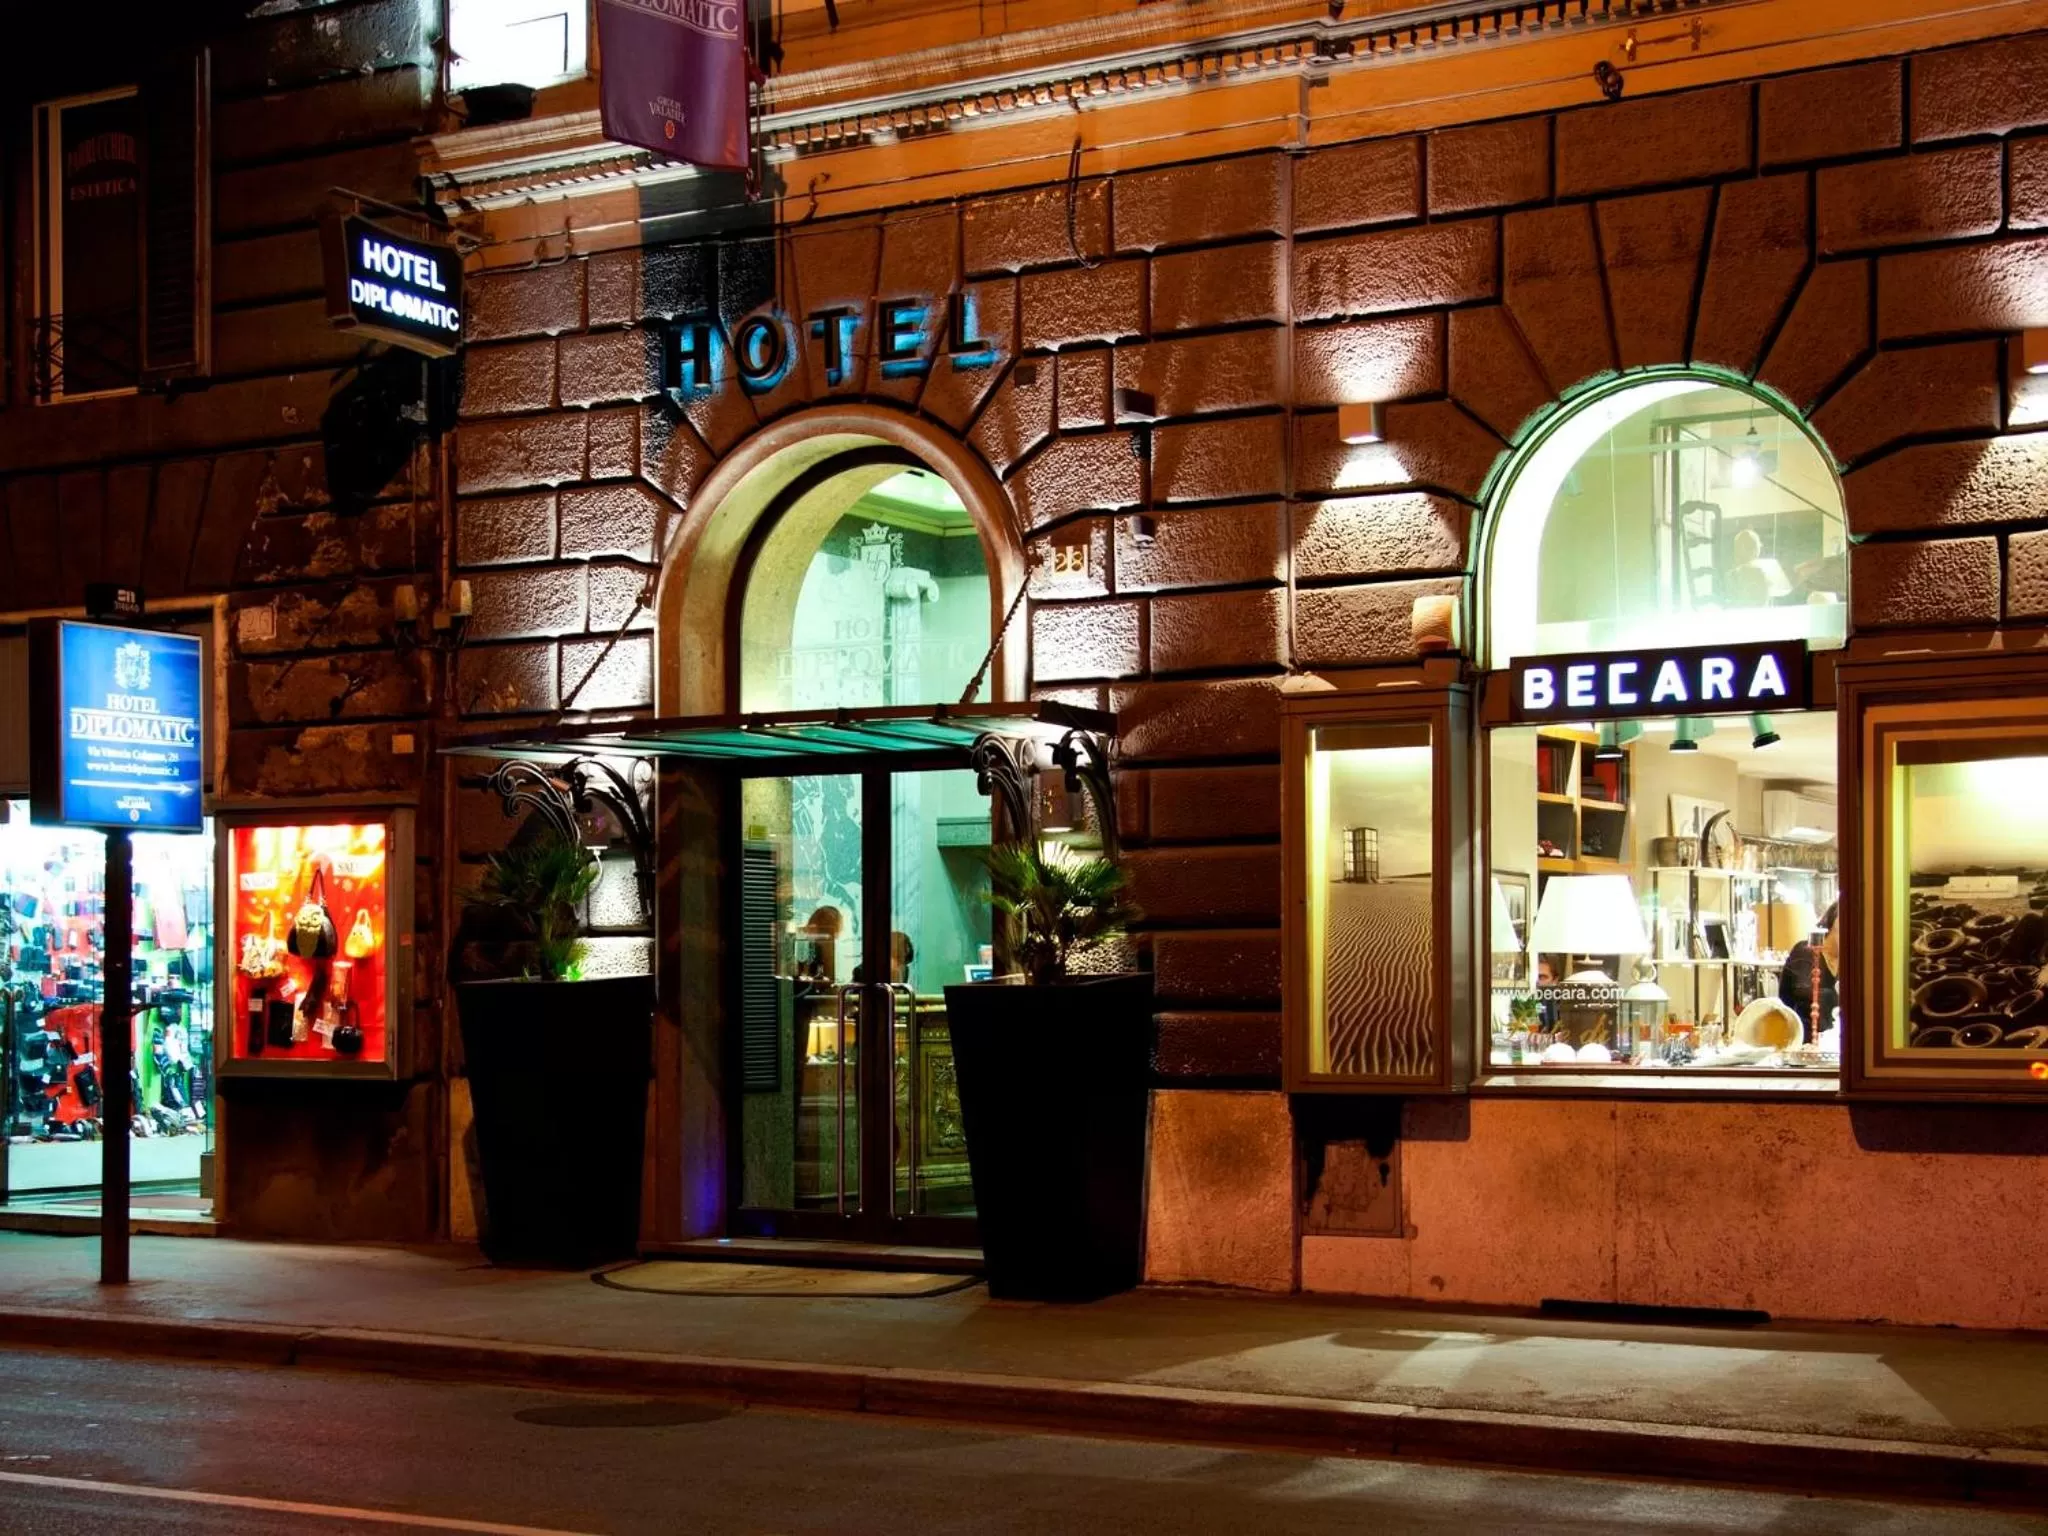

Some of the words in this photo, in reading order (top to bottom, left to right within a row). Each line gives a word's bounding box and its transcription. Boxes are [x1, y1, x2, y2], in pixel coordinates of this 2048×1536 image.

[362, 238, 447, 292] HOTEL
[351, 279, 460, 332] DIPLOMATIC
[664, 293, 995, 392] HOTEL
[1055, 551, 1084, 572] 28
[107, 693, 161, 714] HOTEL
[1522, 653, 1787, 710] BECARA
[71, 713, 194, 743] DIPLOMATIC
